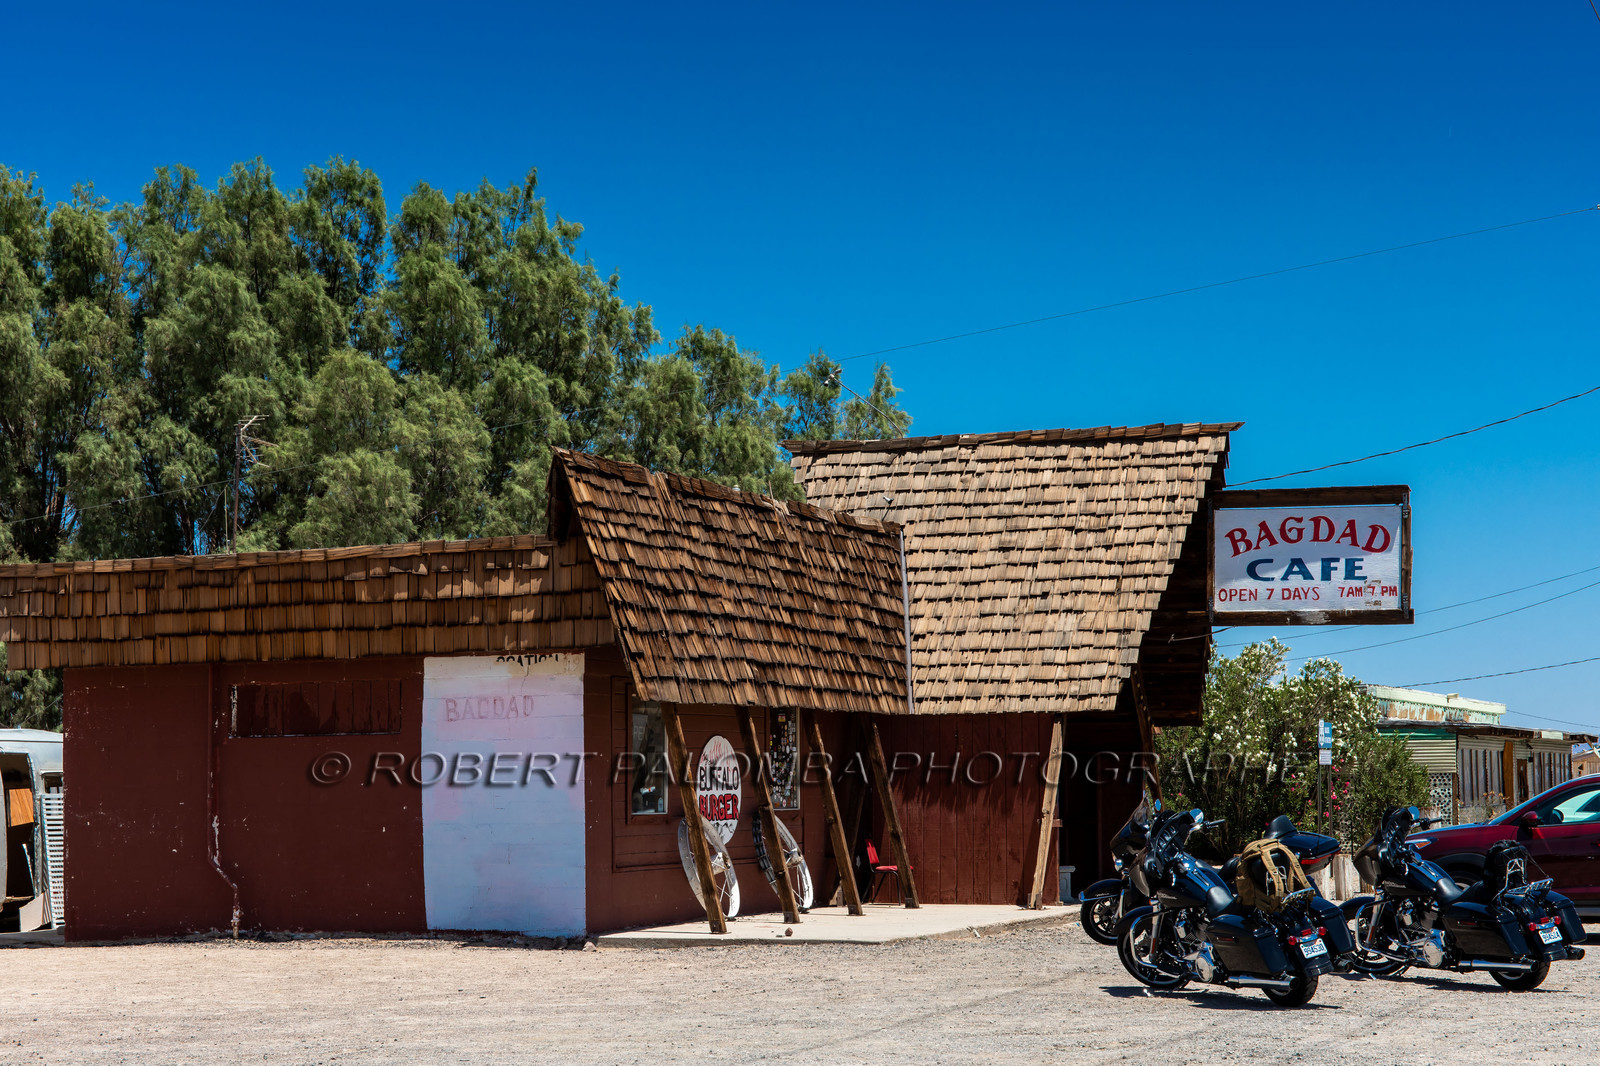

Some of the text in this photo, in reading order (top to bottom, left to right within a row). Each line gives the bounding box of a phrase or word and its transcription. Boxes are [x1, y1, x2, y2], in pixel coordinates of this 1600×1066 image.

[1224, 515, 1391, 558] BAGDAD
[1246, 557, 1367, 582] CAFE
[1218, 585, 1398, 602] OPEN 7 DAYS 7AM 7 PM
[699, 765, 739, 791] BUFFALO
[699, 793, 739, 821] BURGER
